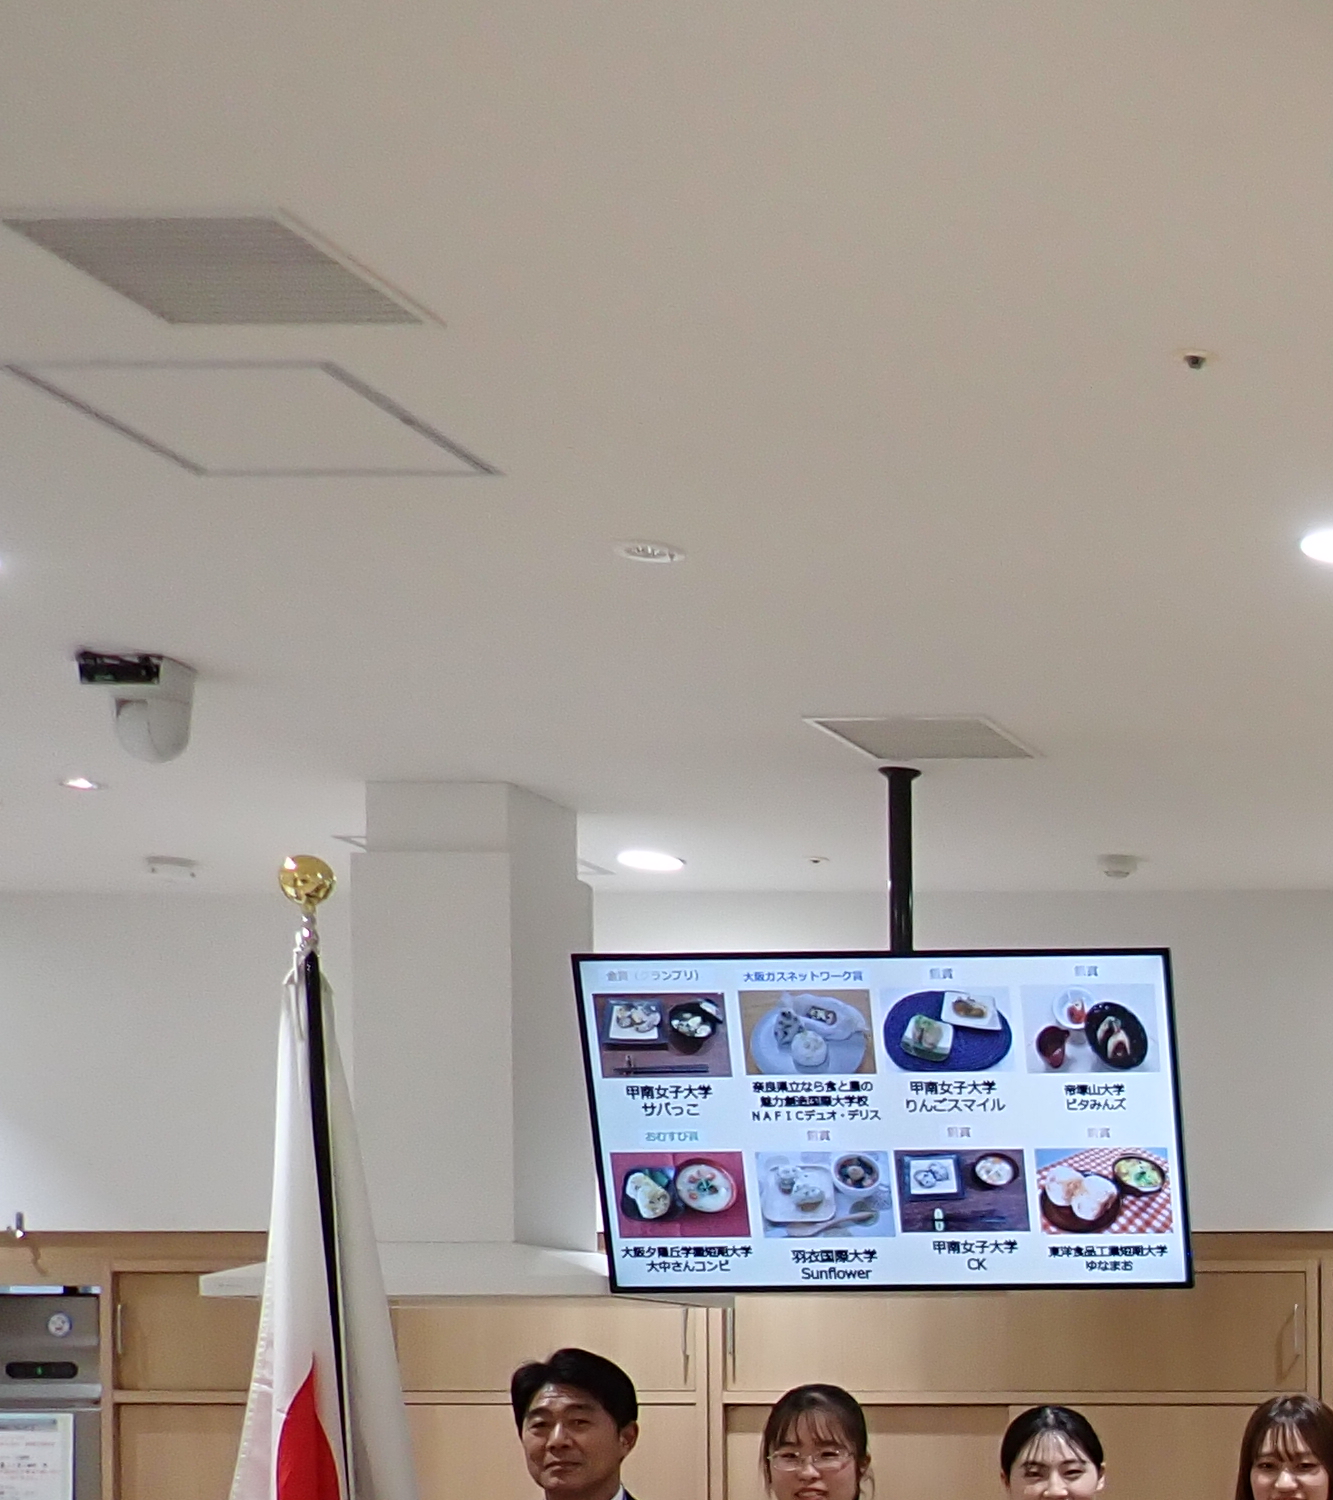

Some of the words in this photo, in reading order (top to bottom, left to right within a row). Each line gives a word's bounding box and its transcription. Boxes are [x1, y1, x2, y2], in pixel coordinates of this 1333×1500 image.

[626, 1085, 713, 1100] 甲南女子大学
[910, 1081, 997, 1096] 甲南女子大学
[641, 1102, 700, 1117] サバっこ
[905, 1098, 1006, 1113] りんごスマイル
[932, 1240, 1019, 1255] 甲南女子大学
[792, 1249, 878, 1264] 羽衣国際大学
[967, 1258, 987, 1271] CK
[1085, 1260, 1133, 1272] ゆなまお
[802, 1267, 873, 1280] Sunflower
